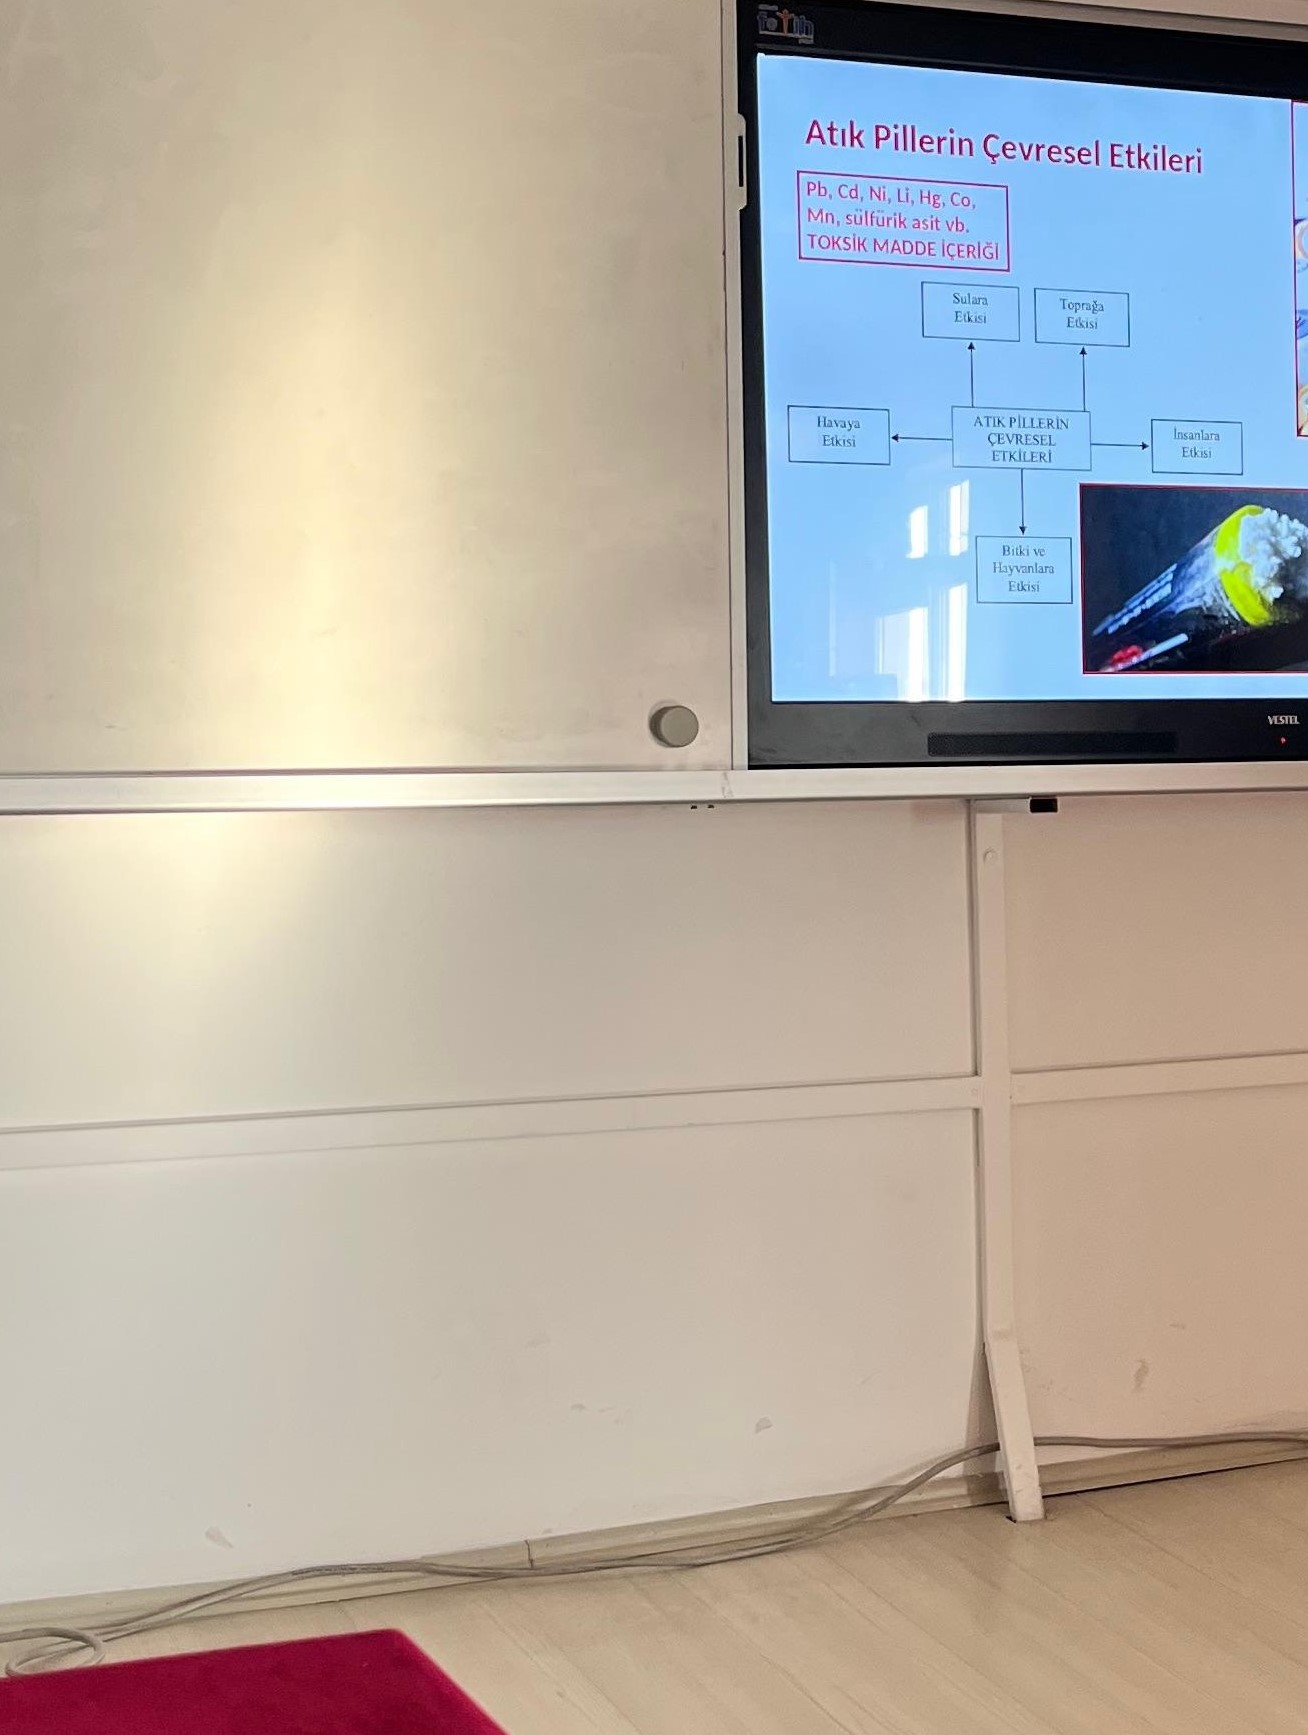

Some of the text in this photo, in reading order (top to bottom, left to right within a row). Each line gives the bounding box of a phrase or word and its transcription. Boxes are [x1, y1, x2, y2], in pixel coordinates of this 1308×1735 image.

[805, 119, 1203, 174] Atık Pillerin Çevresel Etkileri
[806, 180, 977, 210] Pb, Cd, Ni, Li, Hg, Co,
[807, 207, 970, 234] Mn, sülfürik asit vb.
[807, 232, 1000, 261] TOKSİK MADDE İÇERİĞİ
[952, 292, 989, 307] Sulara
[1059, 298, 1105, 314] Toprağa
[954, 310, 988, 324] Etkisi
[1066, 316, 1099, 330] Etkisi
[817, 416, 861, 432] Havaya
[974, 415, 1070, 430] ATIK PİLLERİN
[822, 434, 857, 448] Etkisi
[987, 432, 1056, 447] ÇEVRESEL
[1173, 426, 1221, 442] İnsanlara
[992, 449, 1052, 464] ETKİLERİ
[1182, 446, 1213, 459] Etkisi
[1002, 545, 1046, 557] Bitki ve
[993, 561, 1055, 577] Hayvanlara
[1008, 580, 1040, 592] Etkisi
[1267, 715, 1301, 725] VESTEL
